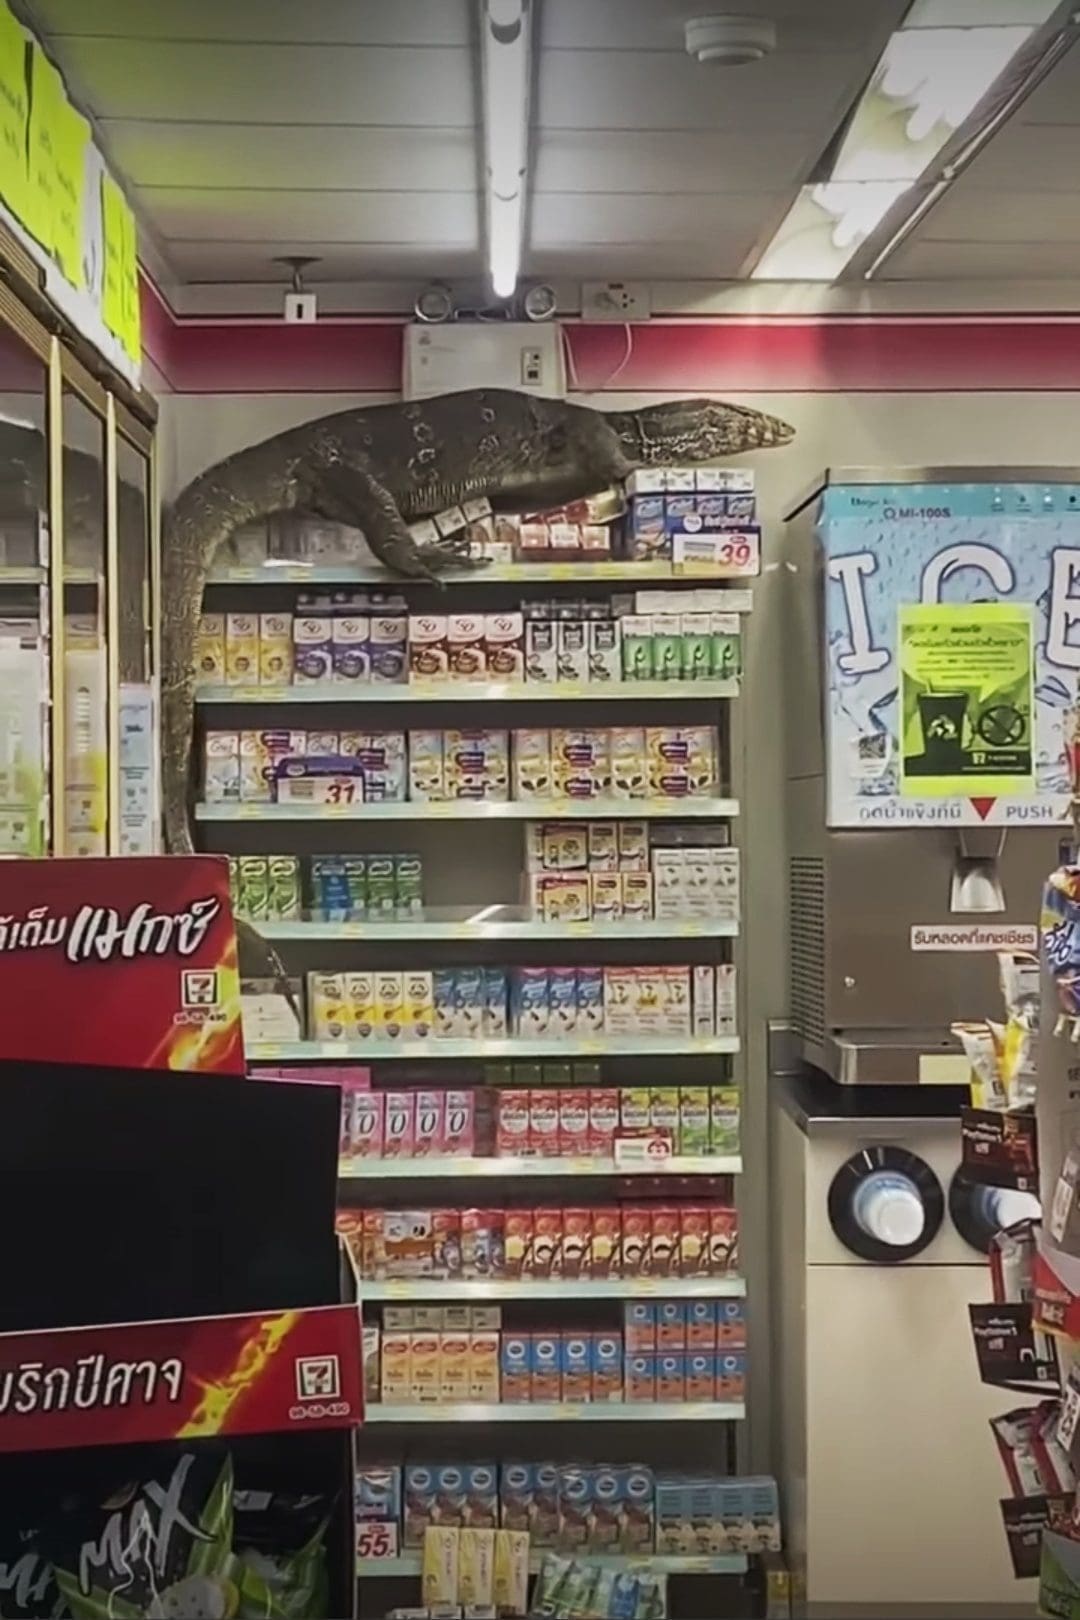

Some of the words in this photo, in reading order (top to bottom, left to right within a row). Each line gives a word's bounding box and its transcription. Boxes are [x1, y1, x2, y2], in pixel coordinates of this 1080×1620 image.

[719, 544, 751, 567] 39
[326, 784, 354, 803] 31
[1006, 806, 1053, 820] PUSH
[77, 1452, 219, 1596] MAX
